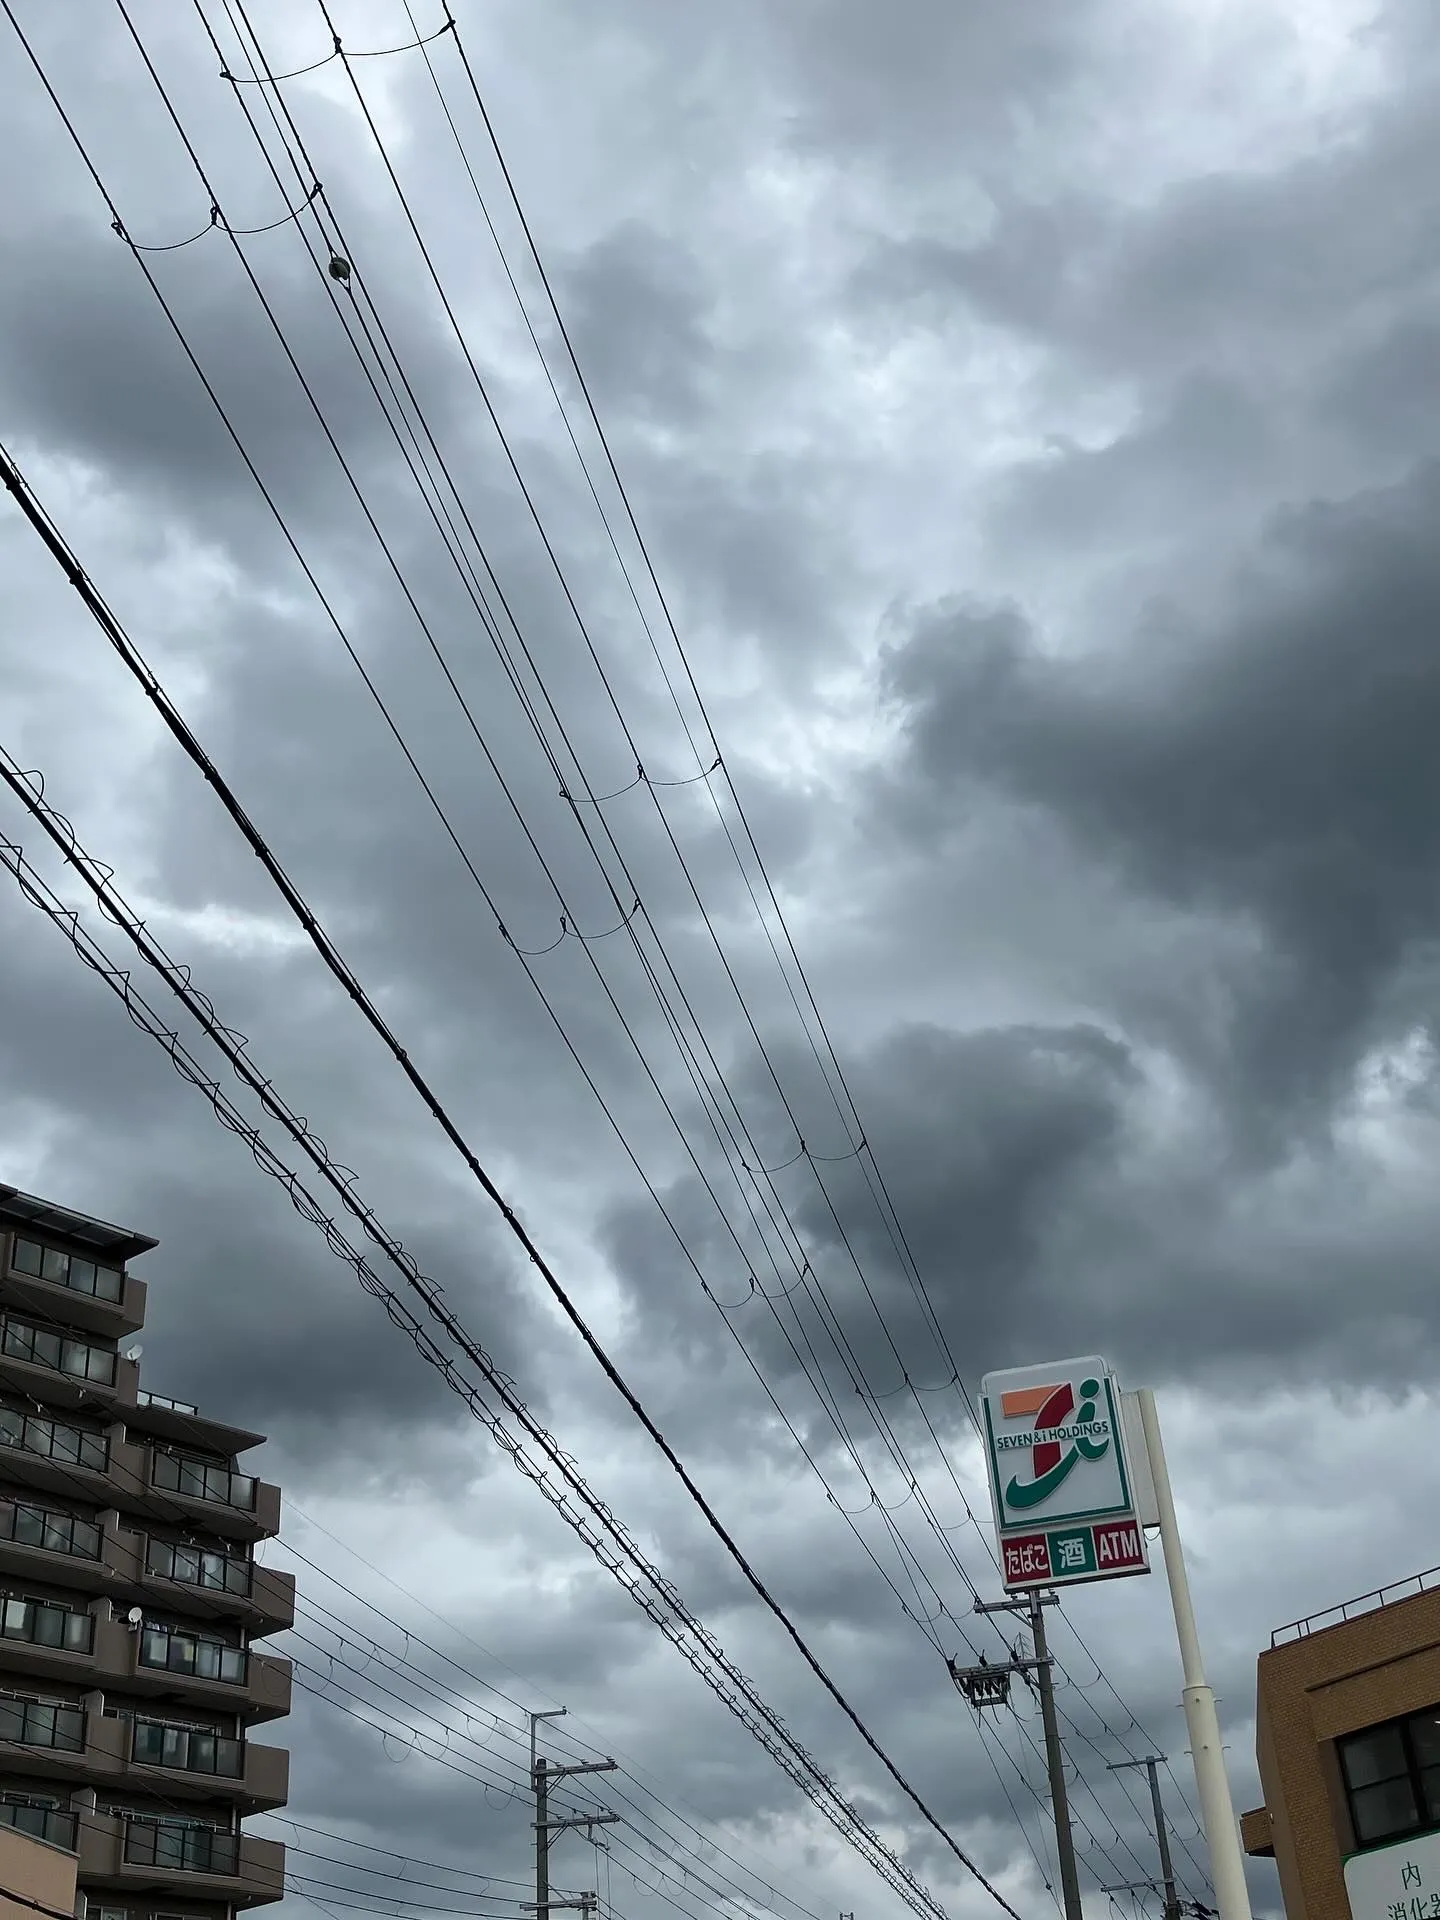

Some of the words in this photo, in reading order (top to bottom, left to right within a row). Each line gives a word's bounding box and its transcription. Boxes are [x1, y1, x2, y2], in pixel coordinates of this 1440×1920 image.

[1049, 1421, 1109, 1441] HOLDINGS
[1006, 1545, 1049, 1576] たばこ
[1058, 1538, 1087, 1568] 酒
[1099, 1530, 1139, 1561] ATM
[1401, 1861, 1421, 1890] 内
